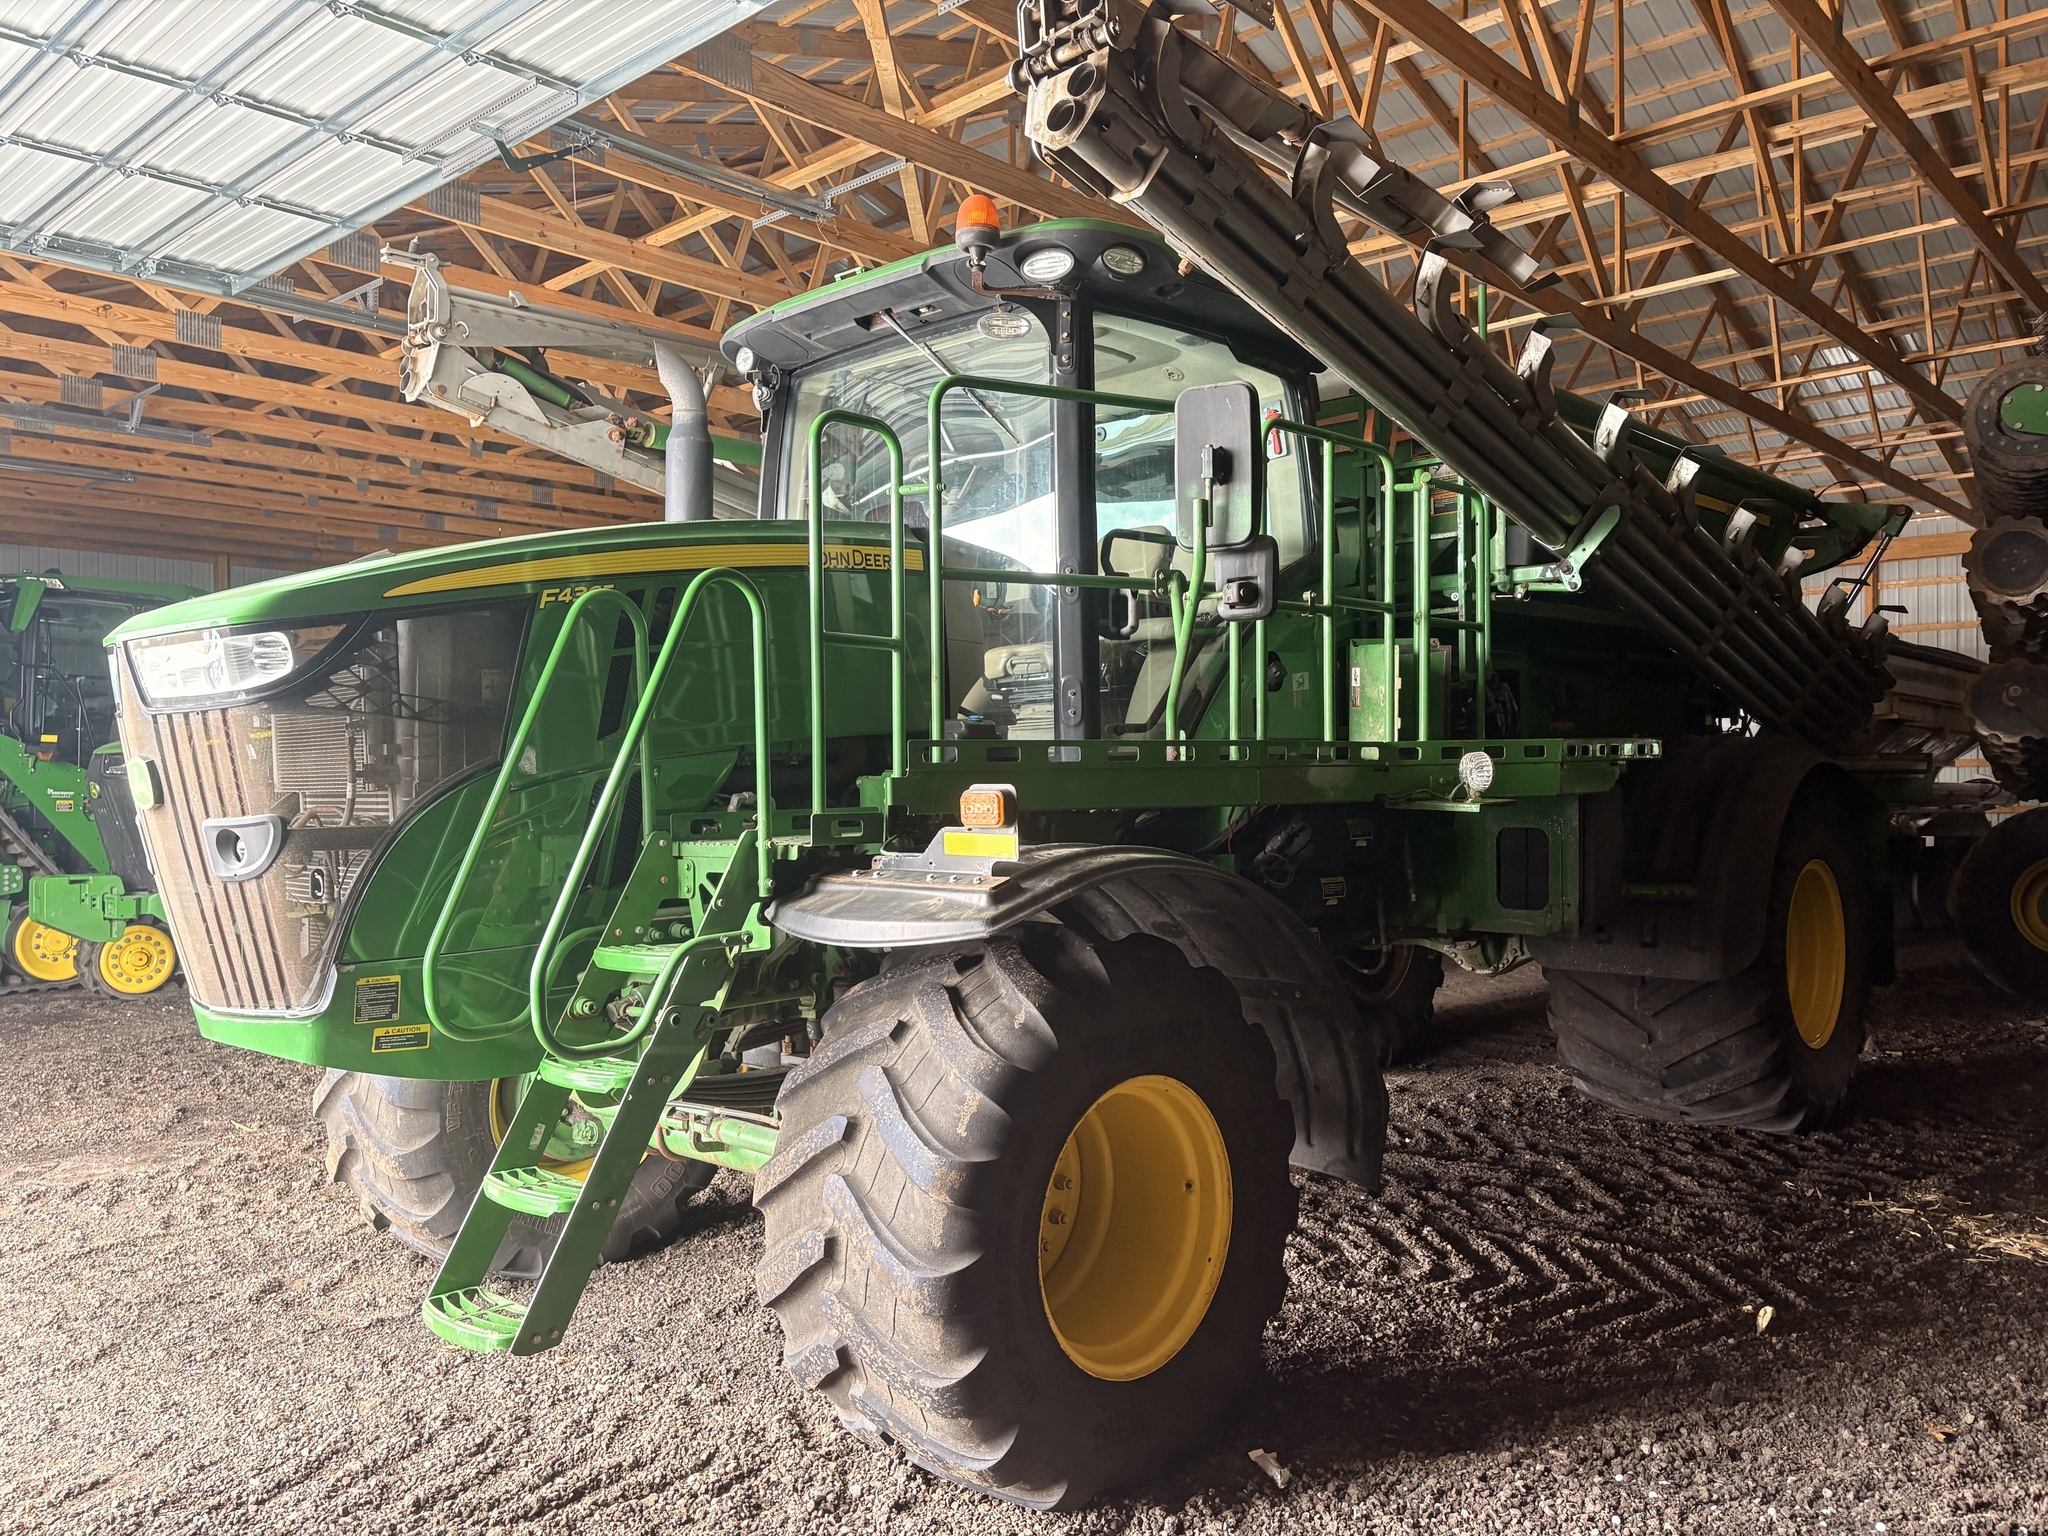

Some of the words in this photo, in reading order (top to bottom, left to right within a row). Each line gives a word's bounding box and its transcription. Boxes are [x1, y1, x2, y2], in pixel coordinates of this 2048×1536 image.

[822, 551, 850, 568] HN
[852, 549, 892, 569] DEER
[539, 584, 615, 609] F43
[391, 1026, 421, 1034] CAUTION
